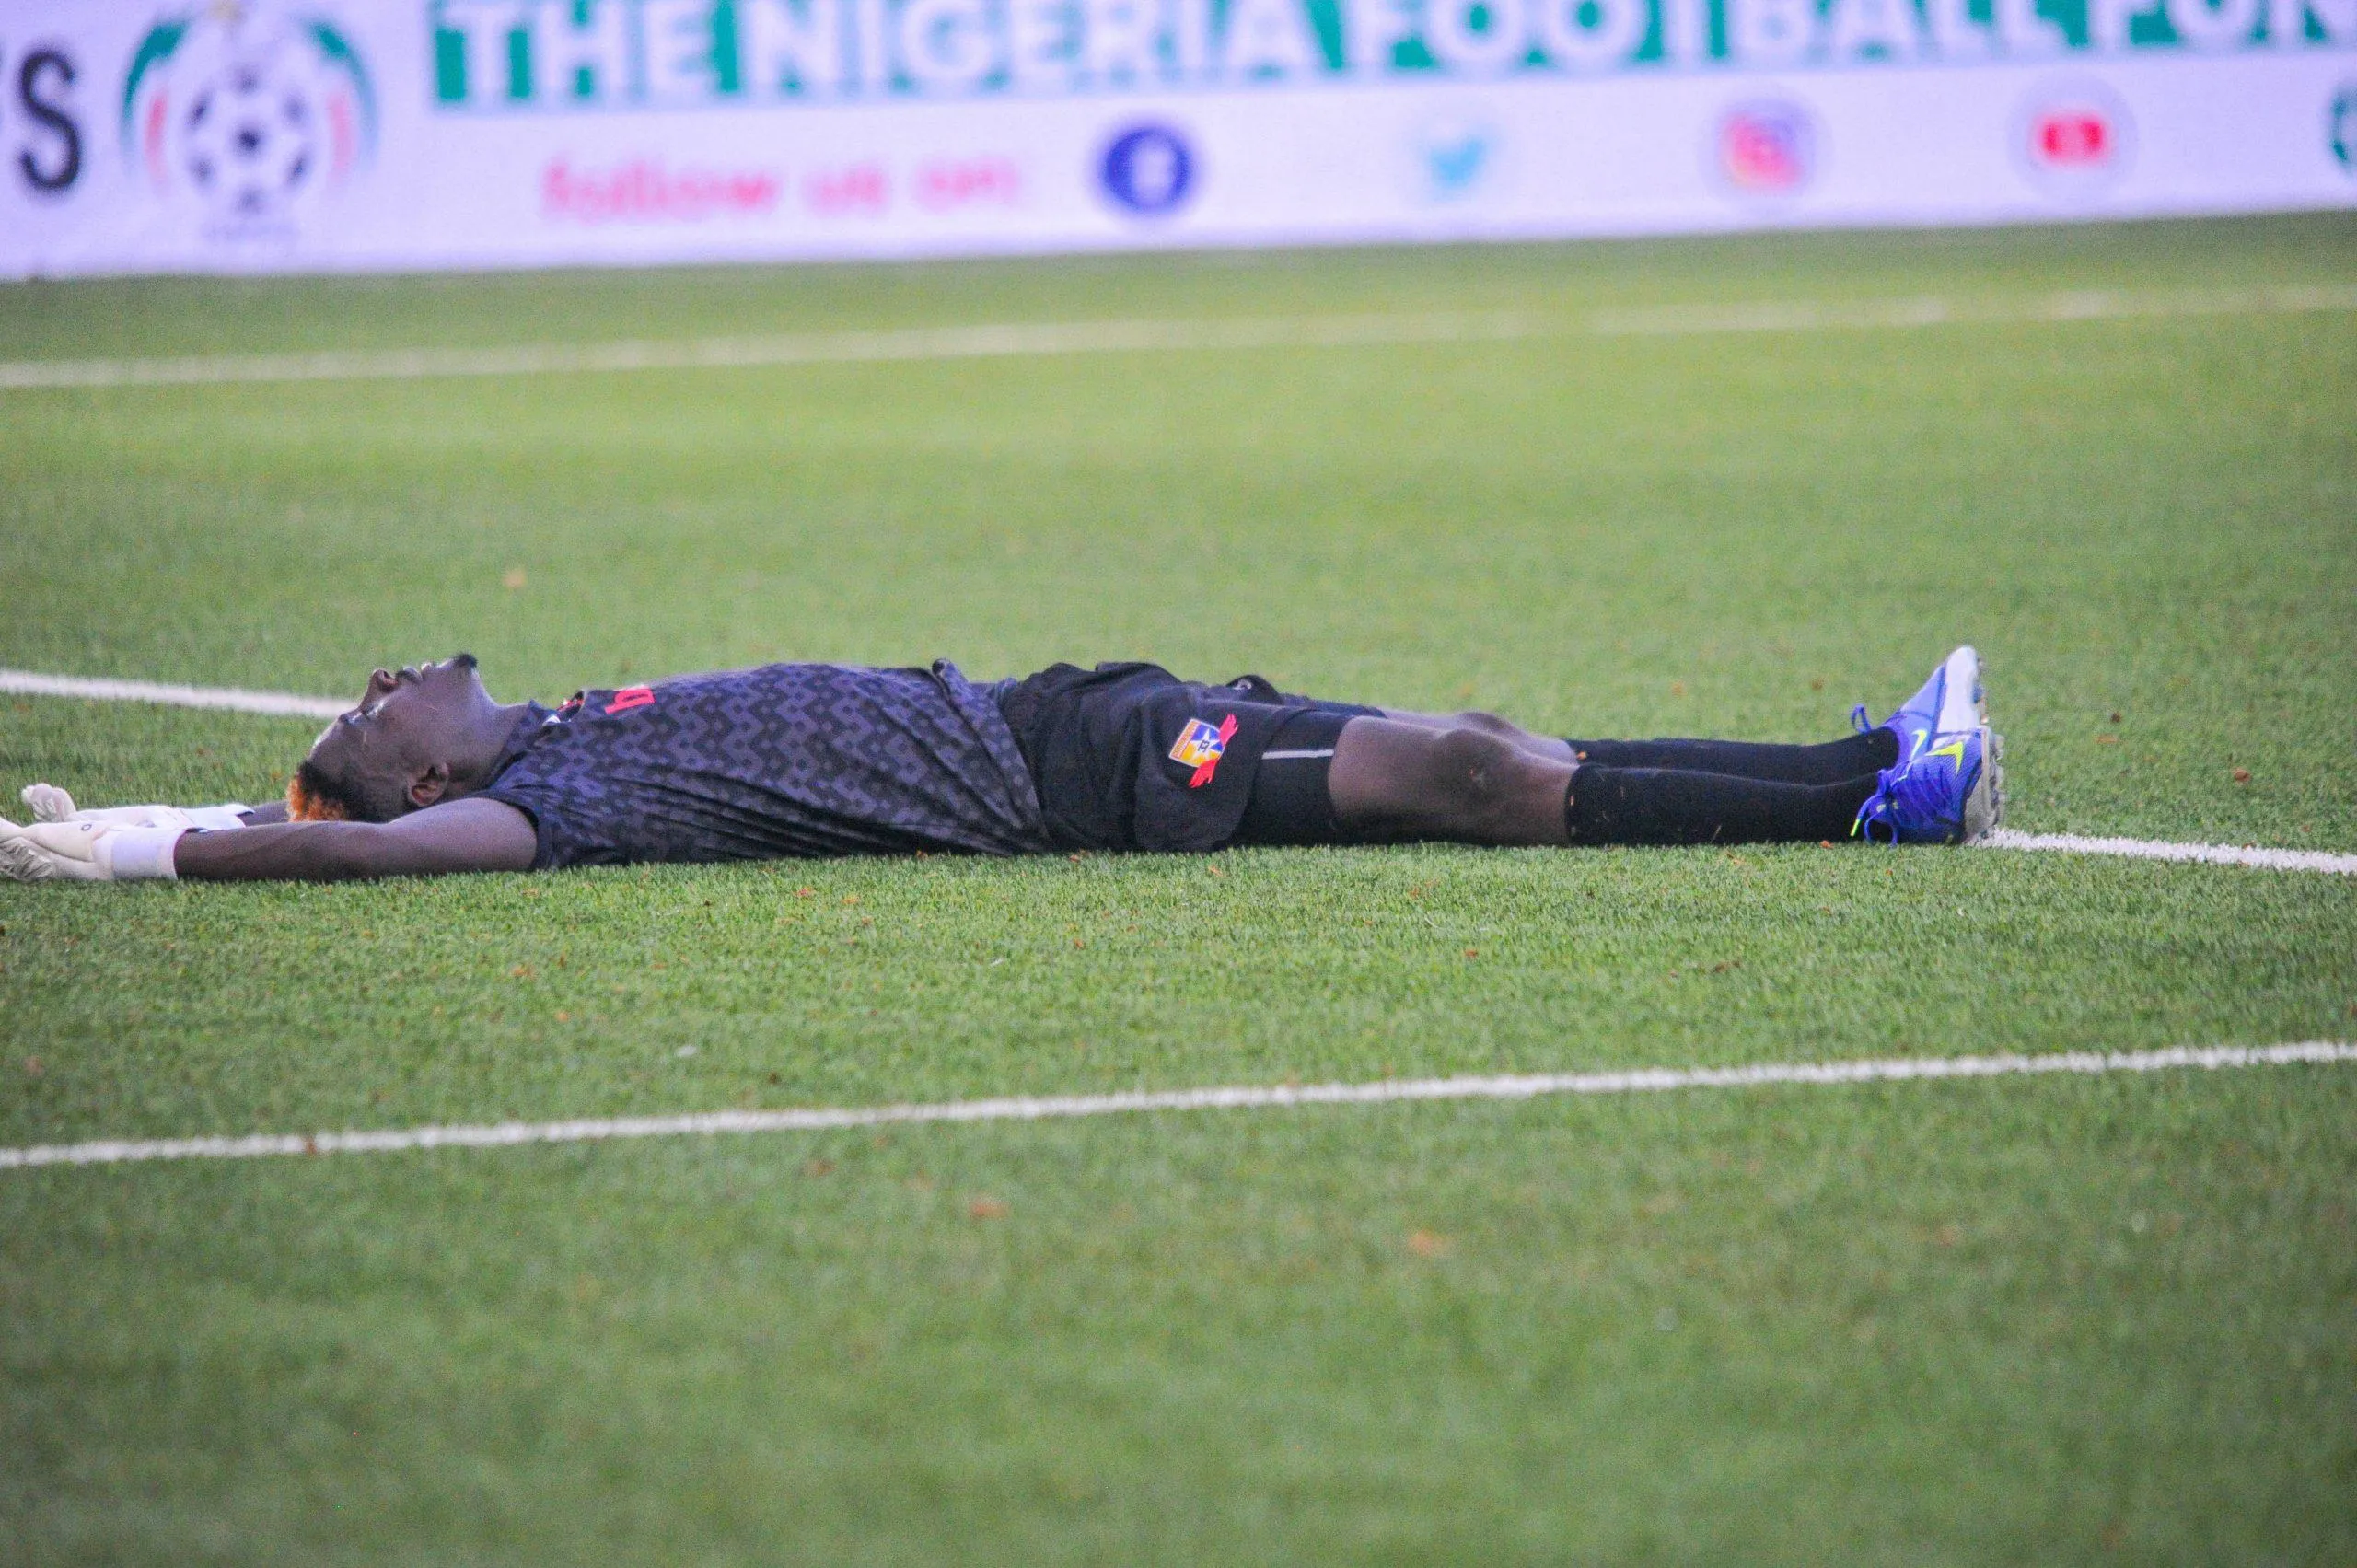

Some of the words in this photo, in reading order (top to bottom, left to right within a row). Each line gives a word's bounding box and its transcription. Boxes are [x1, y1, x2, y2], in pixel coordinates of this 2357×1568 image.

[444, 0, 707, 96] THE
[742, 0, 1320, 87] NIGERIA
[1348, 0, 2062, 70] FOOTBALL
